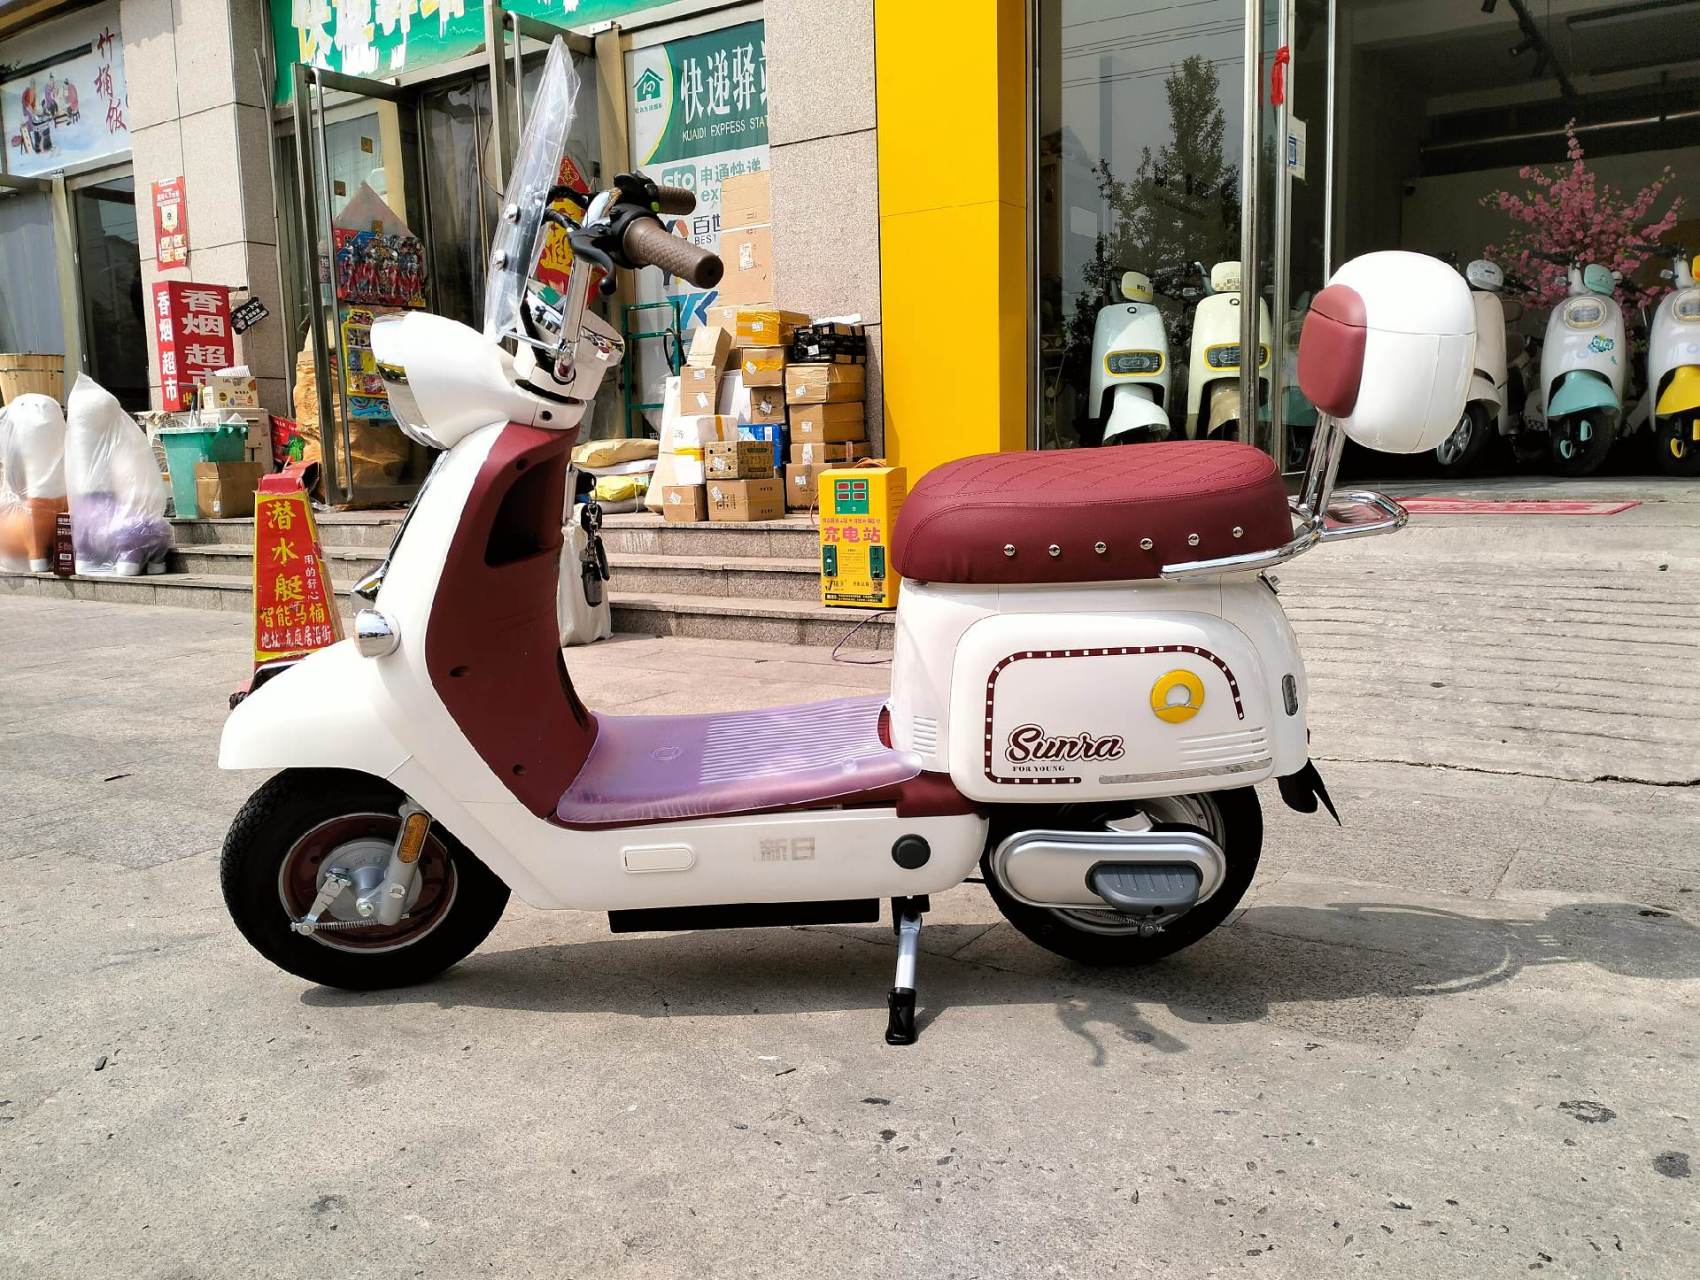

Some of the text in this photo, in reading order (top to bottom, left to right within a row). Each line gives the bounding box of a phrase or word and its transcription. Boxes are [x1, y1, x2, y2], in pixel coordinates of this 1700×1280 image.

[700, 157, 761, 186] 申通快递
[701, 187, 721, 203] ex
[157, 291, 178, 401] 香烟超市
[823, 526, 881, 543] 充电站
[265, 500, 306, 601] 潜水艇
[259, 602, 325, 628] 智能马桶
[1006, 725, 1124, 763] Sunra
